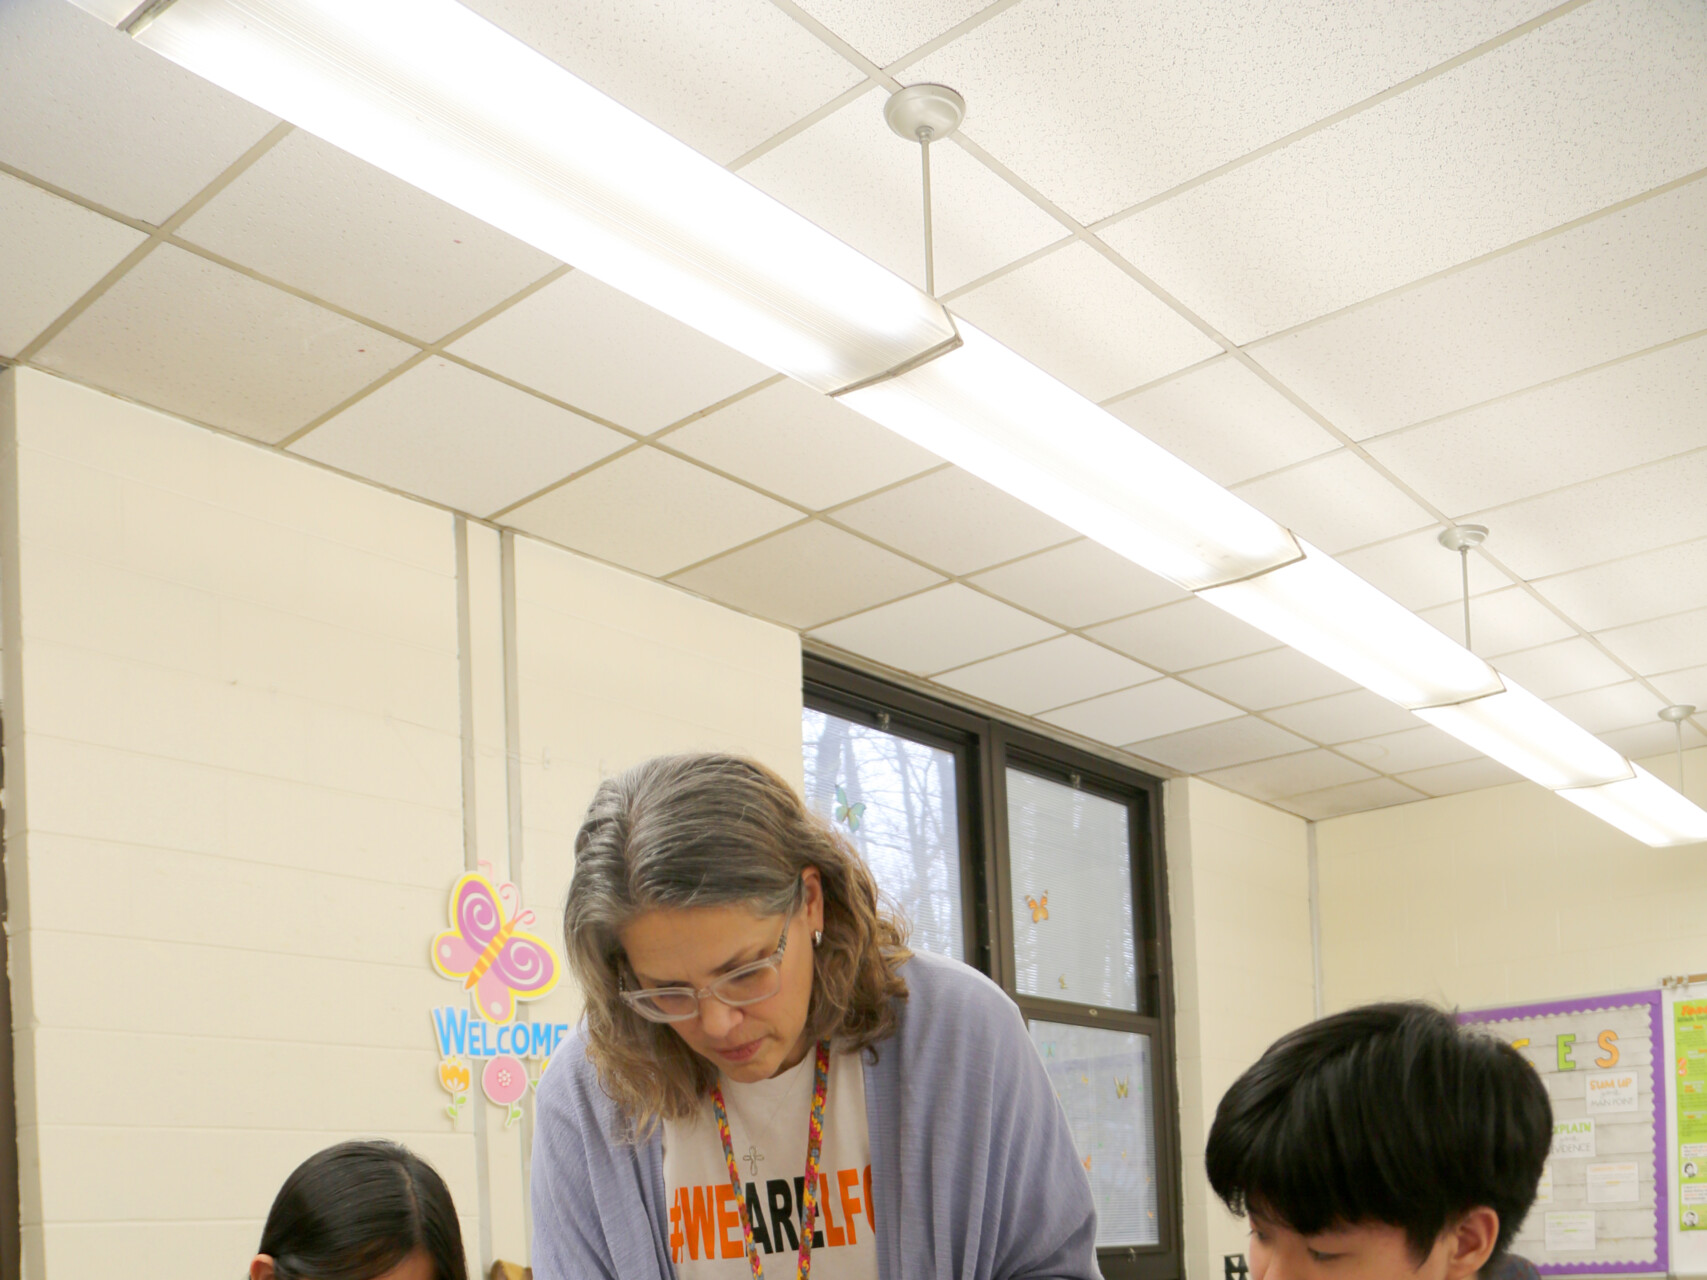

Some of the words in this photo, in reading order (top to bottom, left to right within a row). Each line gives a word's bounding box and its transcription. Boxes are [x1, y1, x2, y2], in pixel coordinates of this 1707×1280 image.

[433, 1006, 568, 1056] WELCOME
[1590, 1079, 1615, 1090] SUM
[1617, 1077, 1632, 1088] UP
[1553, 1122, 1591, 1134] XPLAIN
